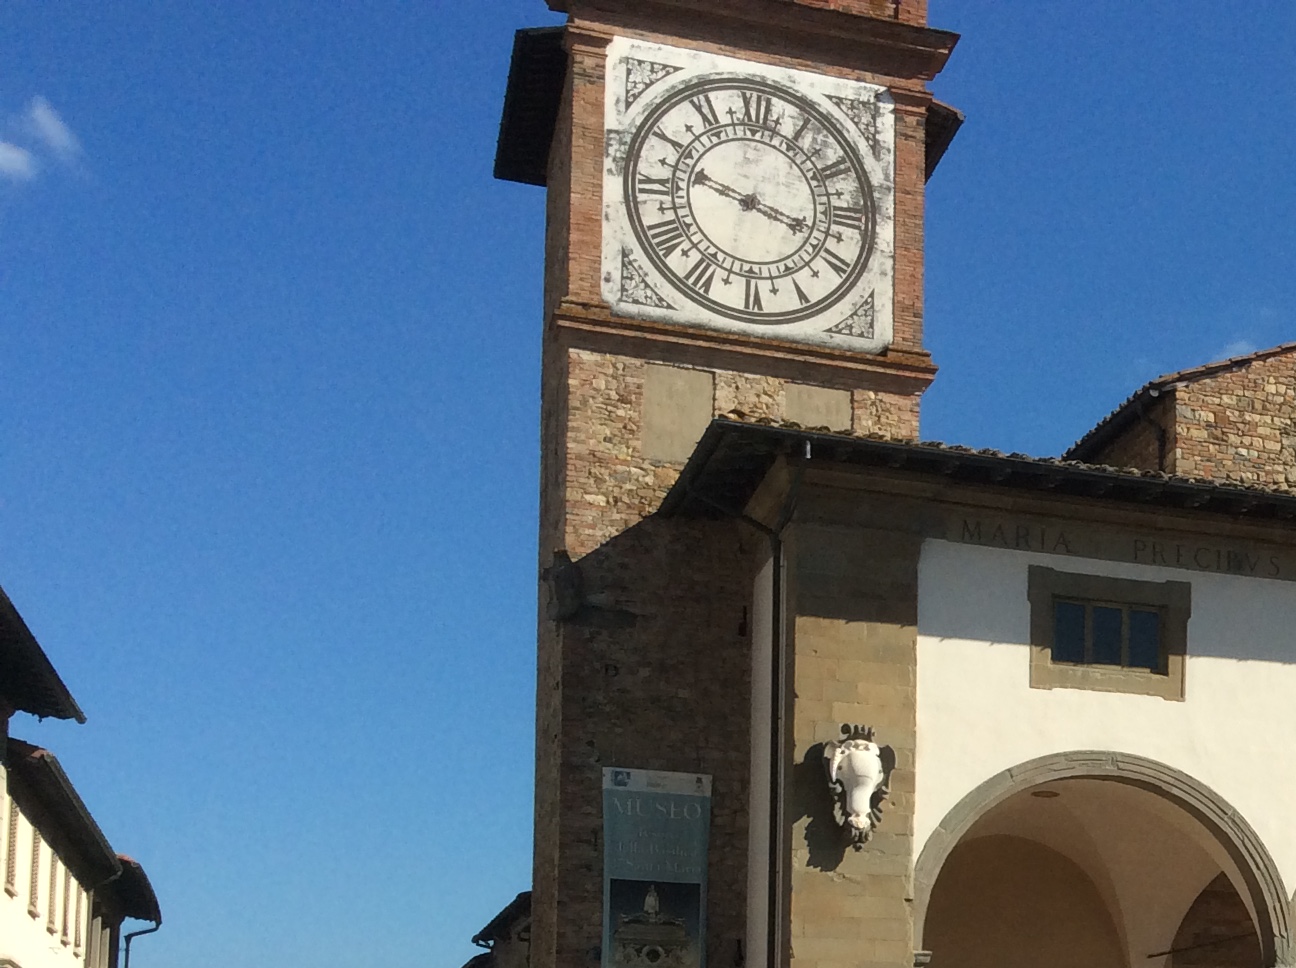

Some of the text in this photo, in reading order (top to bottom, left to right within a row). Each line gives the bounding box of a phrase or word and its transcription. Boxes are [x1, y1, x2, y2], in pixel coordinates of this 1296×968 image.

[689, 93, 720, 127] XI
[741, 91, 772, 126] XII
[651, 125, 686, 154] X
[821, 157, 851, 180] II
[637, 171, 671, 197] IX
[832, 206, 865, 231] III
[647, 219, 688, 260] VIII
[683, 257, 718, 297] VII
[791, 276, 811, 306] V
[743, 278, 764, 312] VI
[612, 796, 702, 821] MUSEO
